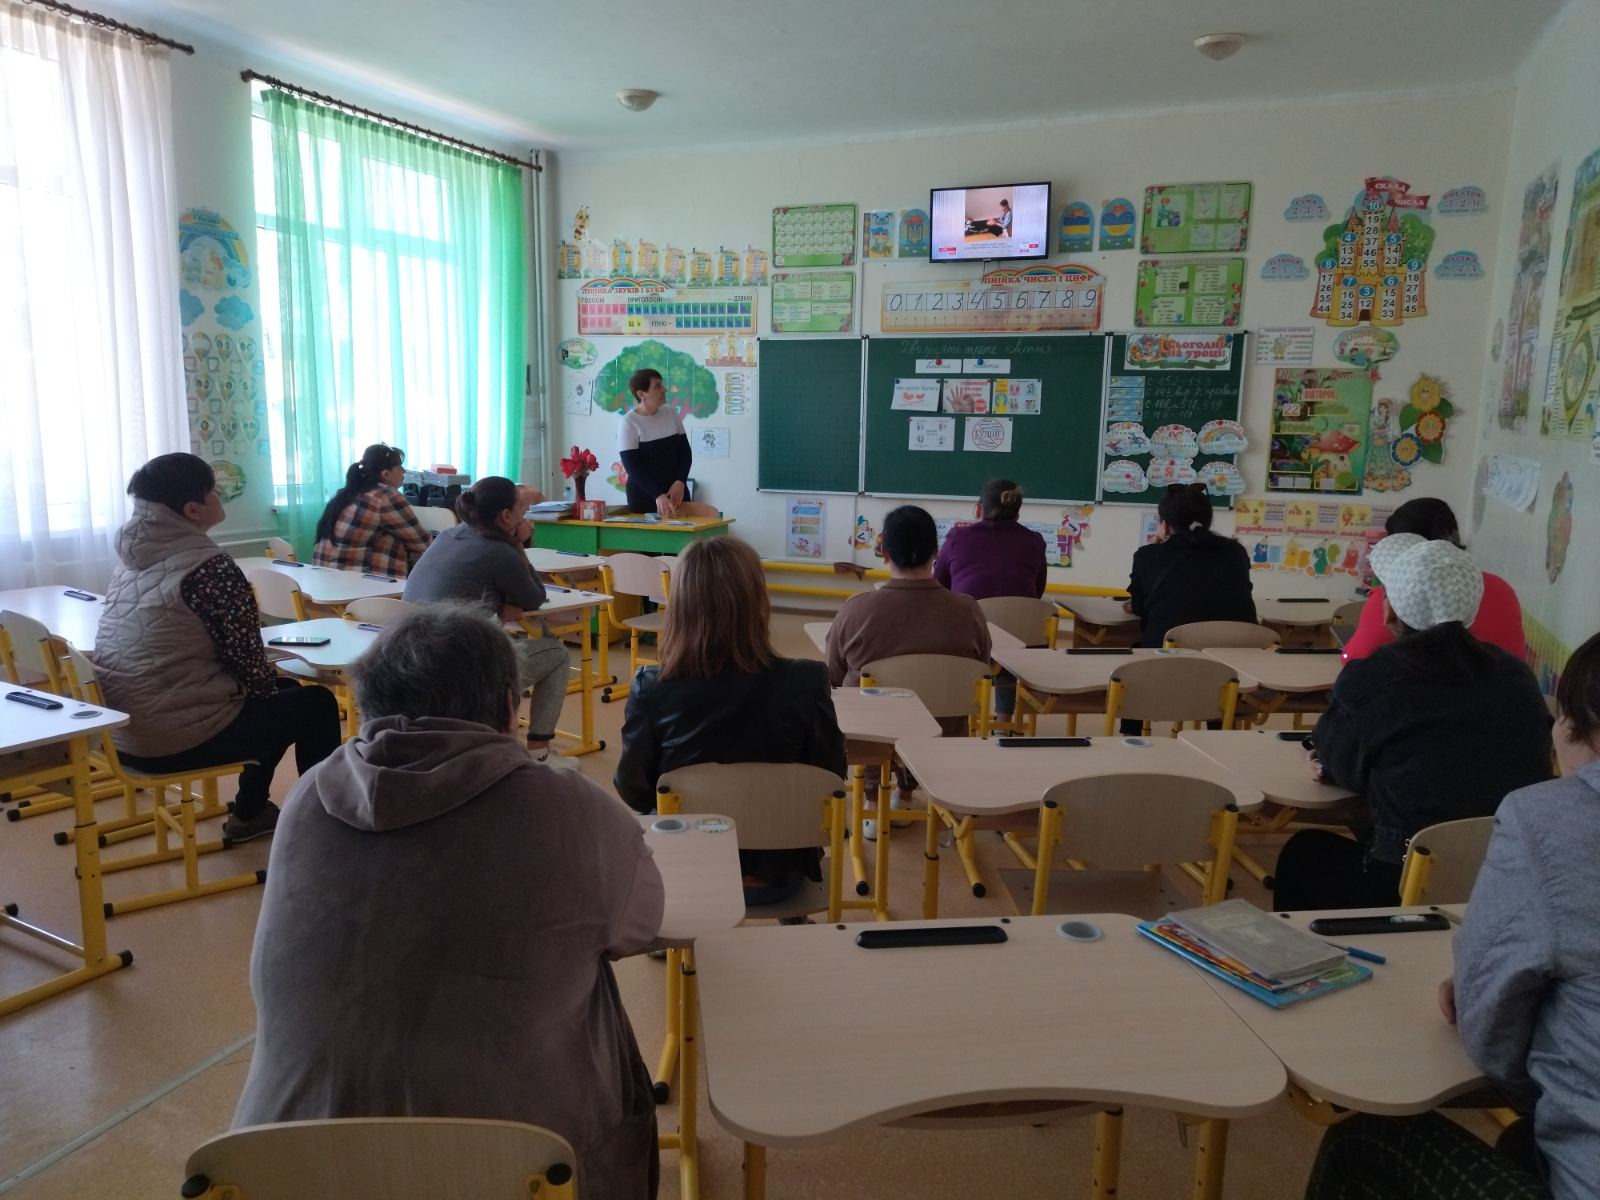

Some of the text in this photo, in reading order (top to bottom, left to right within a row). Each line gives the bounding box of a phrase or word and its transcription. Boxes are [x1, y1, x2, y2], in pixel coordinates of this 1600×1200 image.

[1375, 182, 1406, 193] СКЛАД
[1368, 201, 1380, 211] 10
[1367, 216, 1379, 224] 19
[1366, 226, 1379, 235] 28
[1344, 234, 1352, 242] 4
[1365, 237, 1377, 246] 37
[1390, 235, 1398, 243] 5
[1342, 247, 1354, 255] 13
[1364, 248, 1376, 257] 46
[1387, 246, 1399, 254] 14
[1324, 260, 1331, 268] 8
[1340, 257, 1353, 265] 22
[1363, 259, 1376, 268] 55
[1385, 257, 1398, 265] 23
[1411, 261, 1418, 269] 9
[981, 275, 1021, 287] ЛІНІЙКА
[1024, 275, 1056, 286] ЧИСЕЛ
[1064, 273, 1095, 285] ЦИФР
[1322, 273, 1333, 281] 17
[1408, 274, 1419, 282] 18
[1346, 278, 1353, 286] 7
[1343, 291, 1354, 299] 16
[1362, 288, 1370, 296] 3
[1385, 289, 1396, 297] 15
[890, 289, 1097, 311] 0 1 2 3 4 5 6 7 8 9
[1319, 294, 1332, 302] 35
[1405, 294, 1418, 303] 36
[1342, 301, 1353, 309] 25
[1360, 300, 1371, 309] 12
[1383, 300, 1395, 308] 24
[1318, 304, 1330, 313] 44
[1404, 304, 1417, 313] 45
[1341, 312, 1352, 320] 34
[1382, 310, 1394, 319] 33
[1167, 340, 1225, 350] Сьогодні
